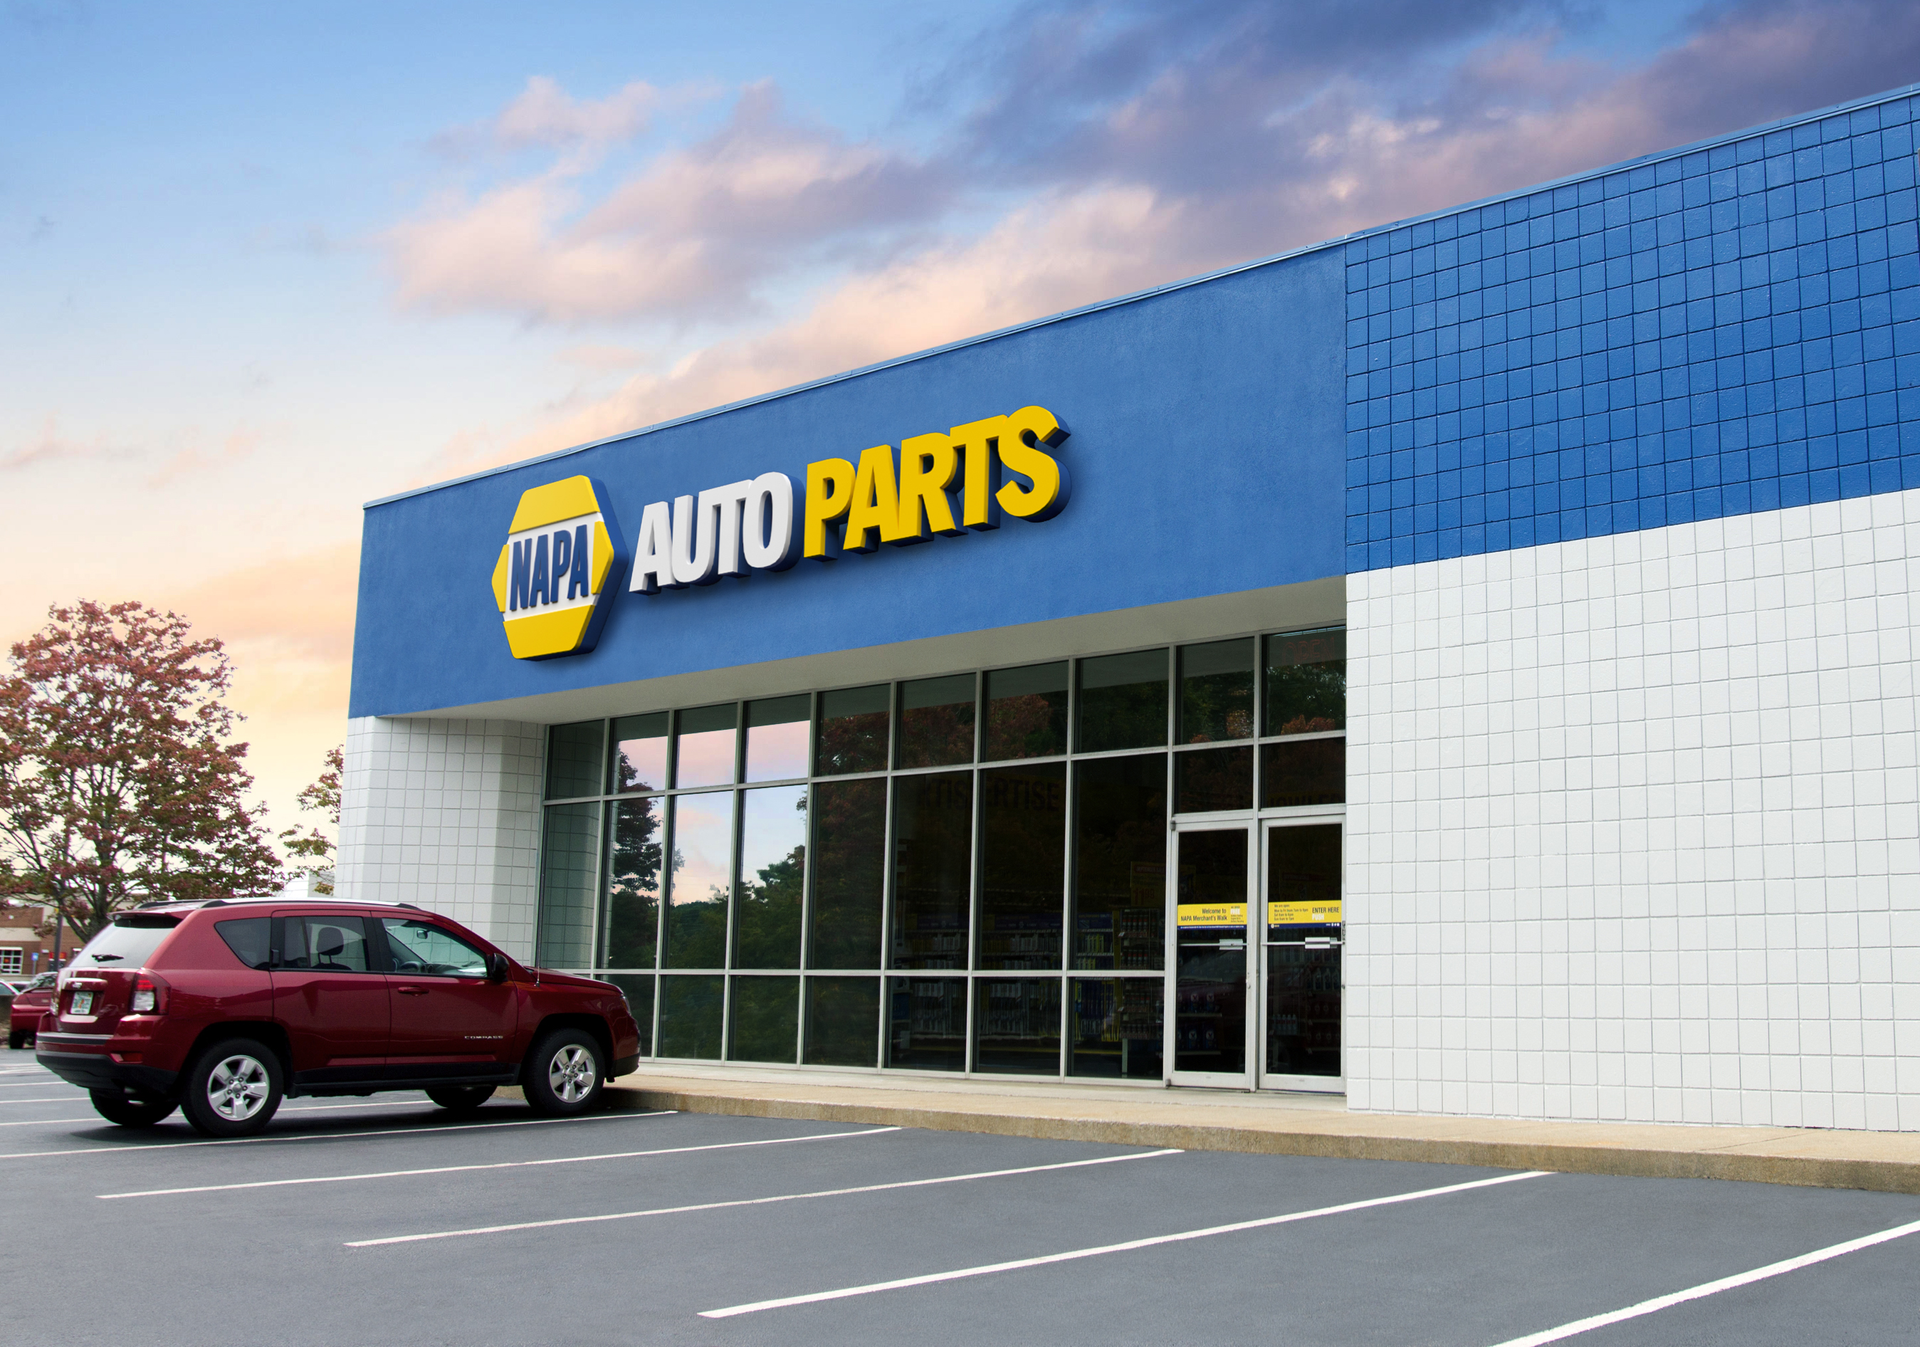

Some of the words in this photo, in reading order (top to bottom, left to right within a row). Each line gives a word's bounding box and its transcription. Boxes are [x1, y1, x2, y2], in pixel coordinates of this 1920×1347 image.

[509, 524, 589, 611] NAPA
[629, 472, 796, 594] AUTO
[803, 405, 1067, 560] PARTS
